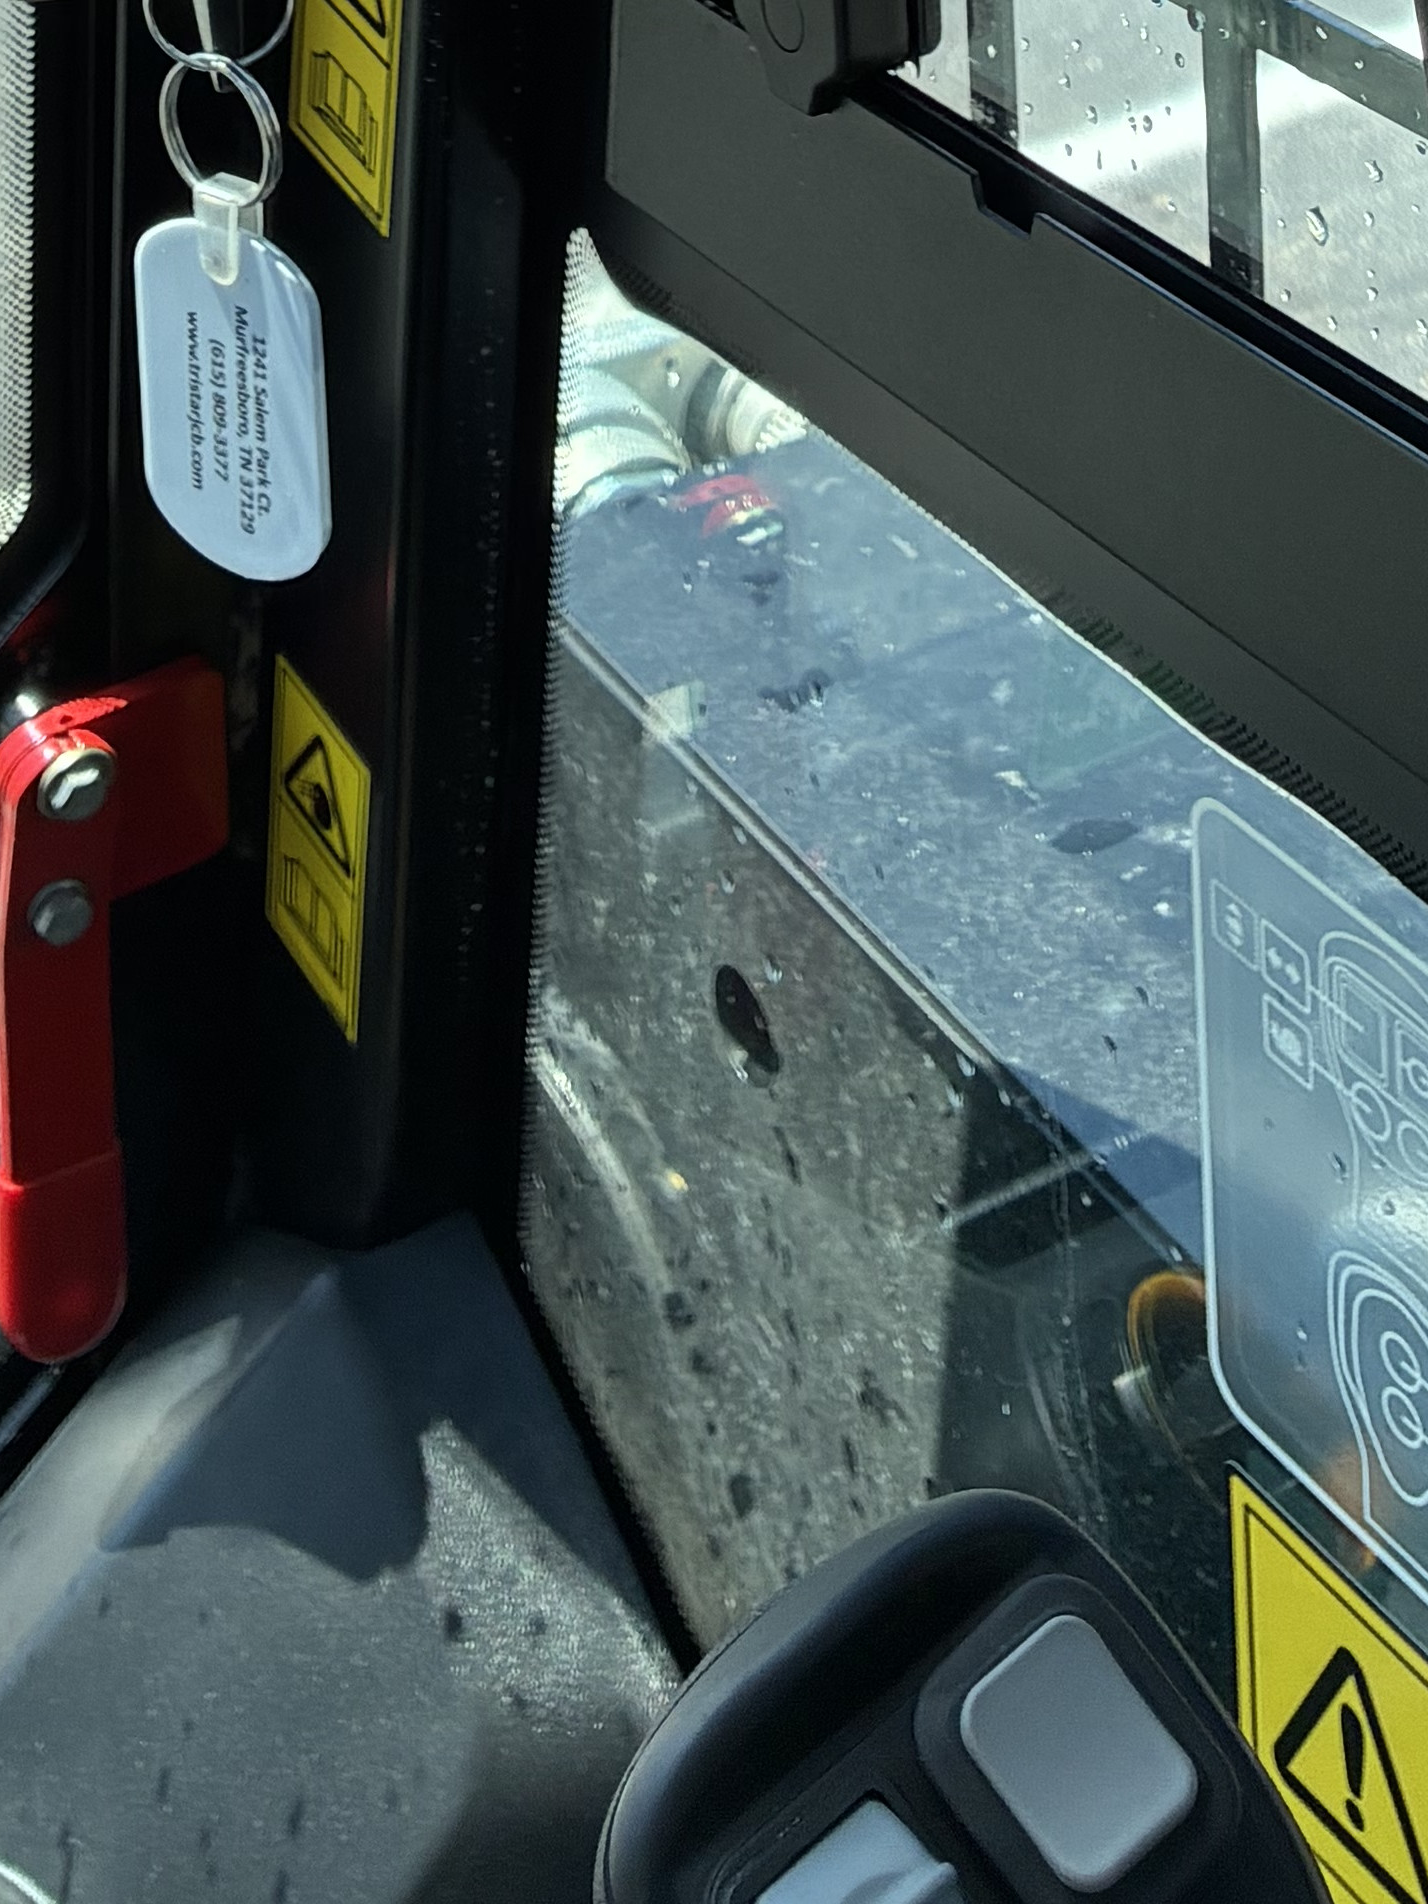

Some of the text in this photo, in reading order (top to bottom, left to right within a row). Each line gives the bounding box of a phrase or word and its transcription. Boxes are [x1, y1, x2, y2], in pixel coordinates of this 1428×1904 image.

[186, 311, 205, 490] www.tristarjcb.com
[207, 338, 229, 483] (615) 809-3377
[234, 303, 256, 536] Murfreesboro, TN 37129
[252, 334, 272, 517] 1241 Salem Park Ct.
